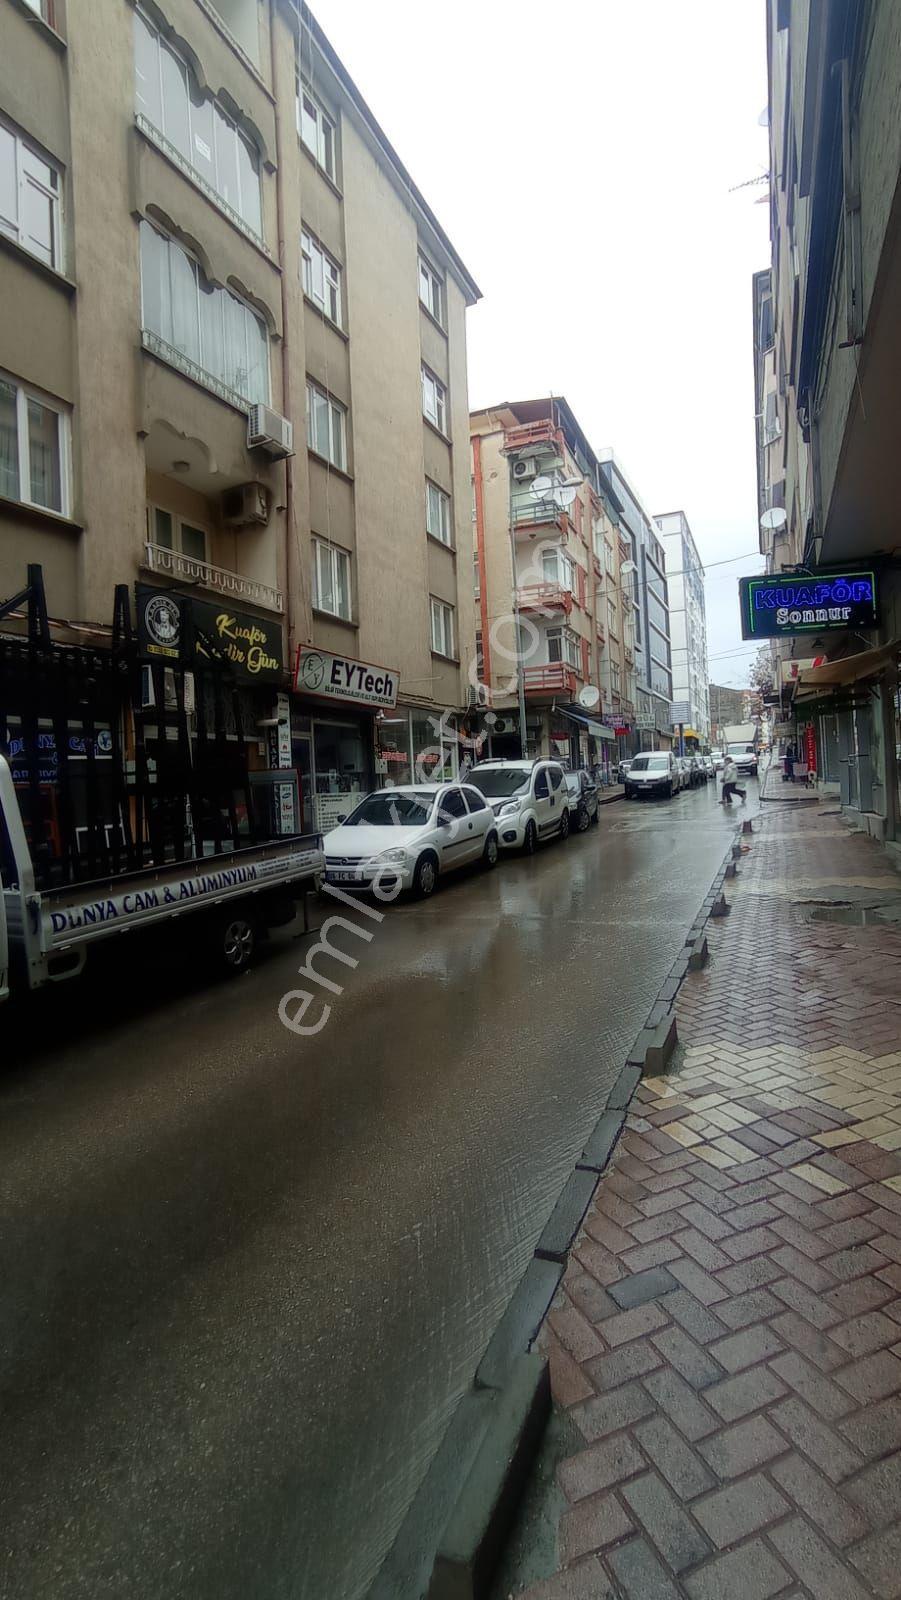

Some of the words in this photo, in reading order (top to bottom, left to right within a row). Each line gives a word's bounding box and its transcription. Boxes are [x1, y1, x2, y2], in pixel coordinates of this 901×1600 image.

[755, 578, 873, 609] KUAFÖR
[216, 614, 267, 646] Kuaför
[776, 607, 852, 624] Sonnur
[247, 646, 279, 673] Gün
[330, 659, 393, 697] EYTech
[50, 900, 118, 933] DÜNYA
[123, 889, 159, 914] CAM
[163, 887, 176, 904] &
